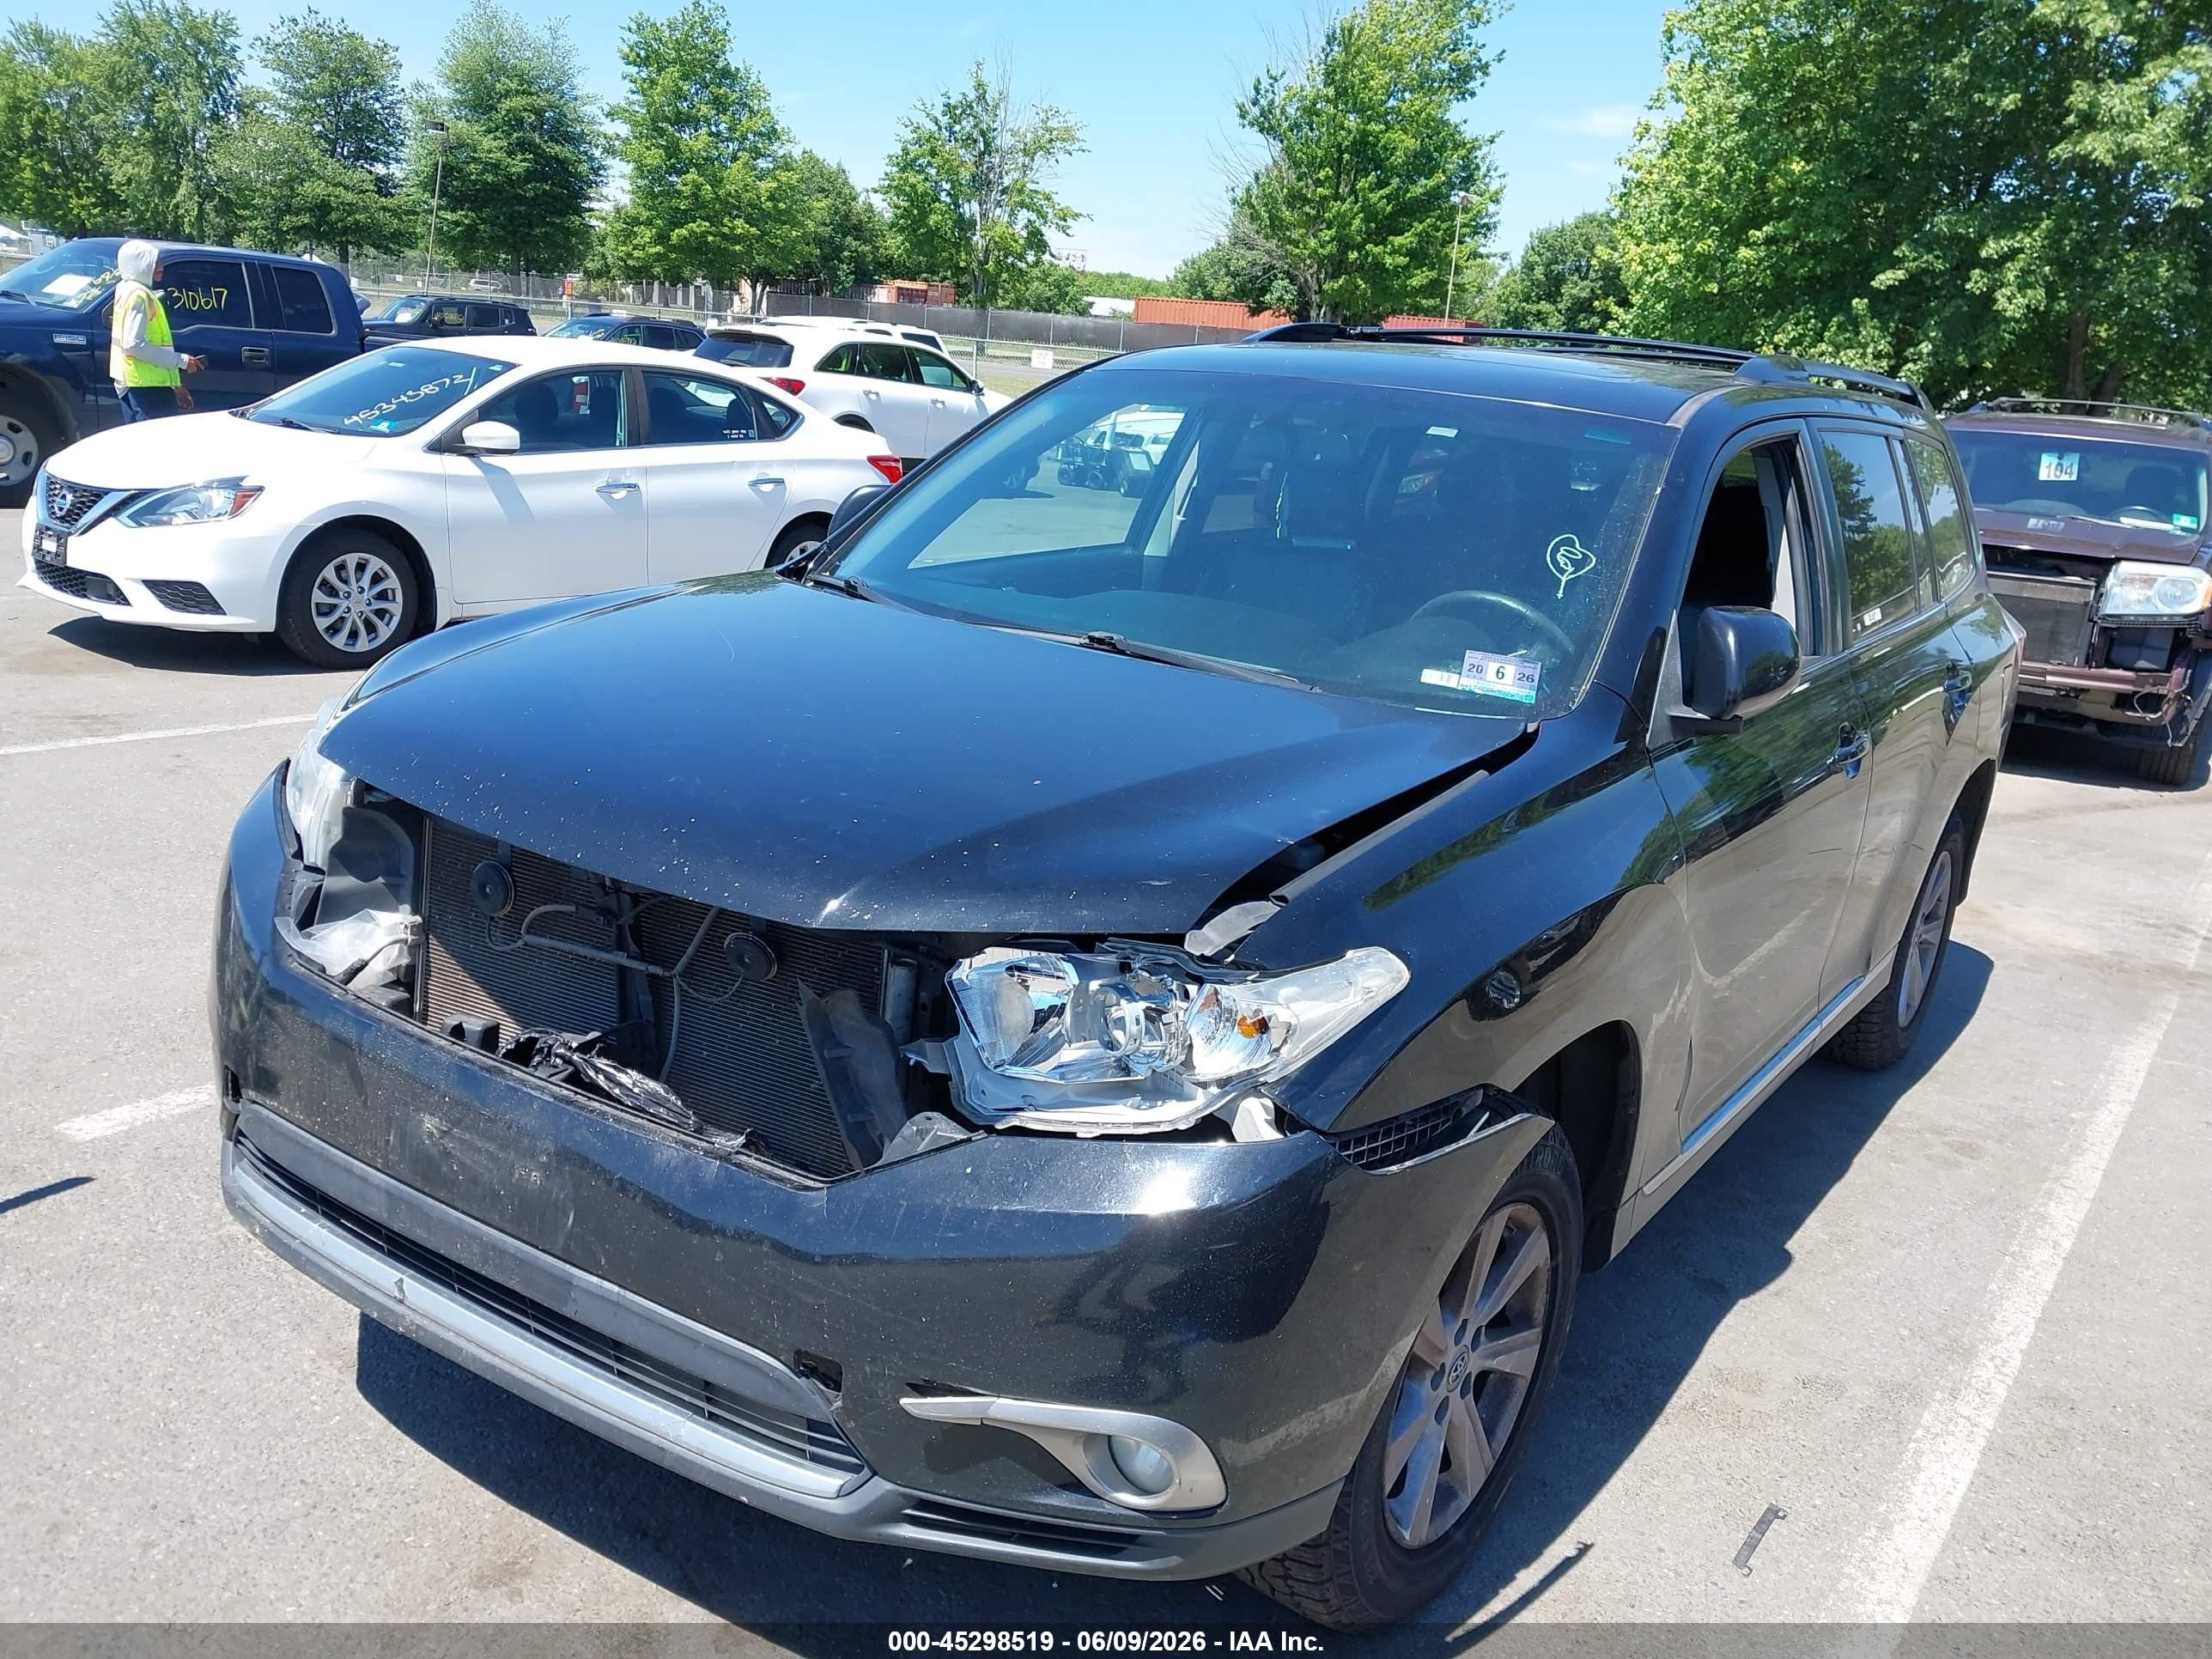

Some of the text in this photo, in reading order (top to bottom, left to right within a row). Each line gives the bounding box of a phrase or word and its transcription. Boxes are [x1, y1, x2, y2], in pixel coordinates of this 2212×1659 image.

[2045, 462, 2075, 478] 104
[1468, 663, 1534, 684] 20 6 26
